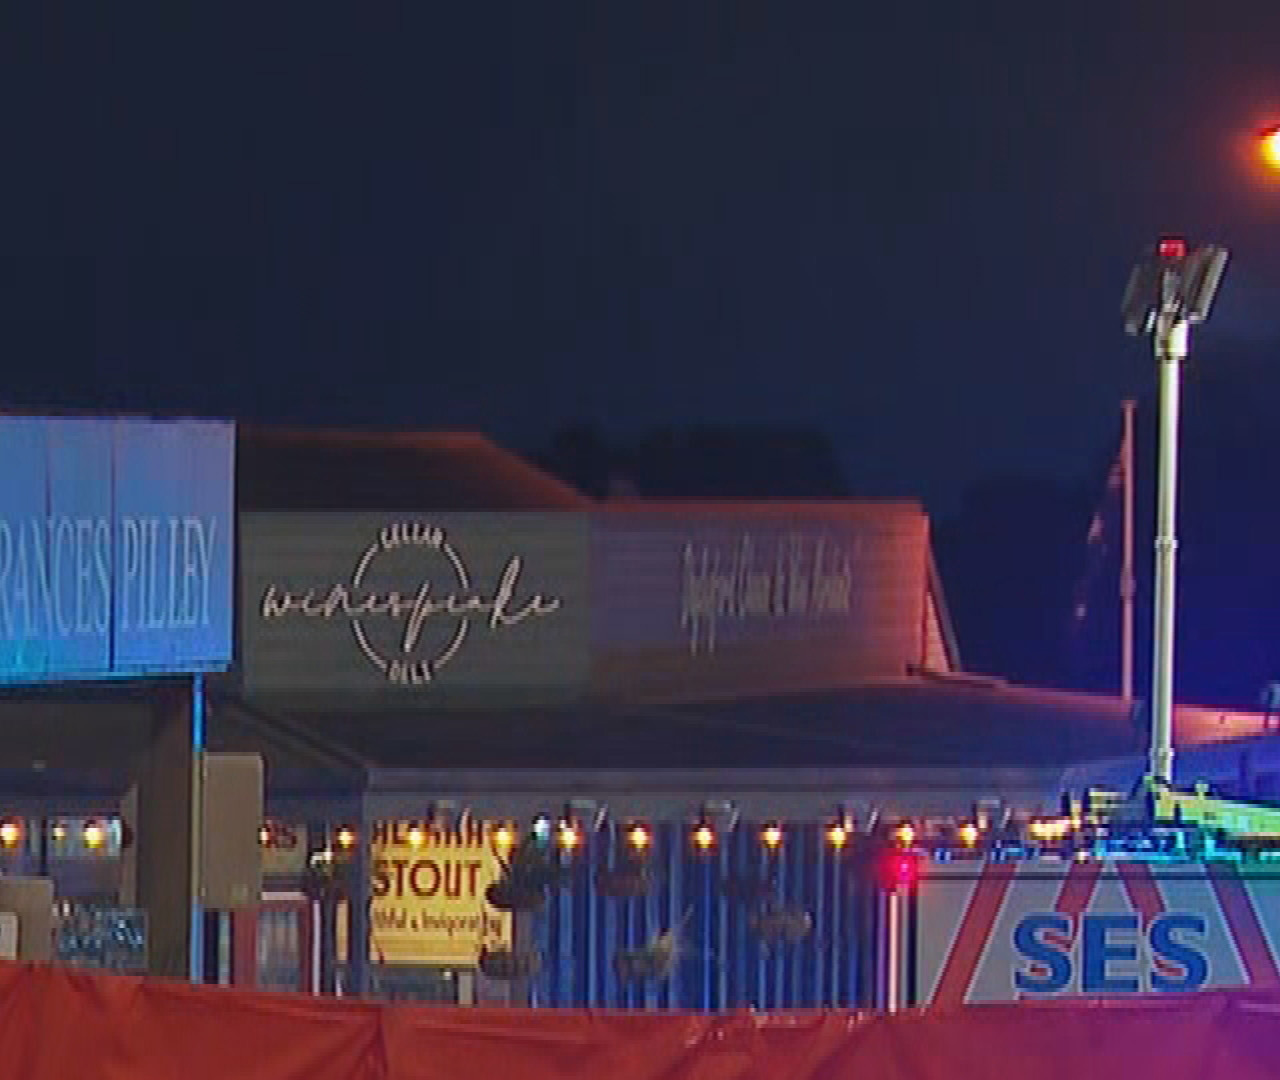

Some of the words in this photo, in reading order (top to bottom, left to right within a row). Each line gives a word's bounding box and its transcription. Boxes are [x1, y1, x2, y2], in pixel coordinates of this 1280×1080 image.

[121, 515, 218, 630] PILLEY
[374, 859, 483, 898] STOUT
[1013, 910, 1209, 993] SES
